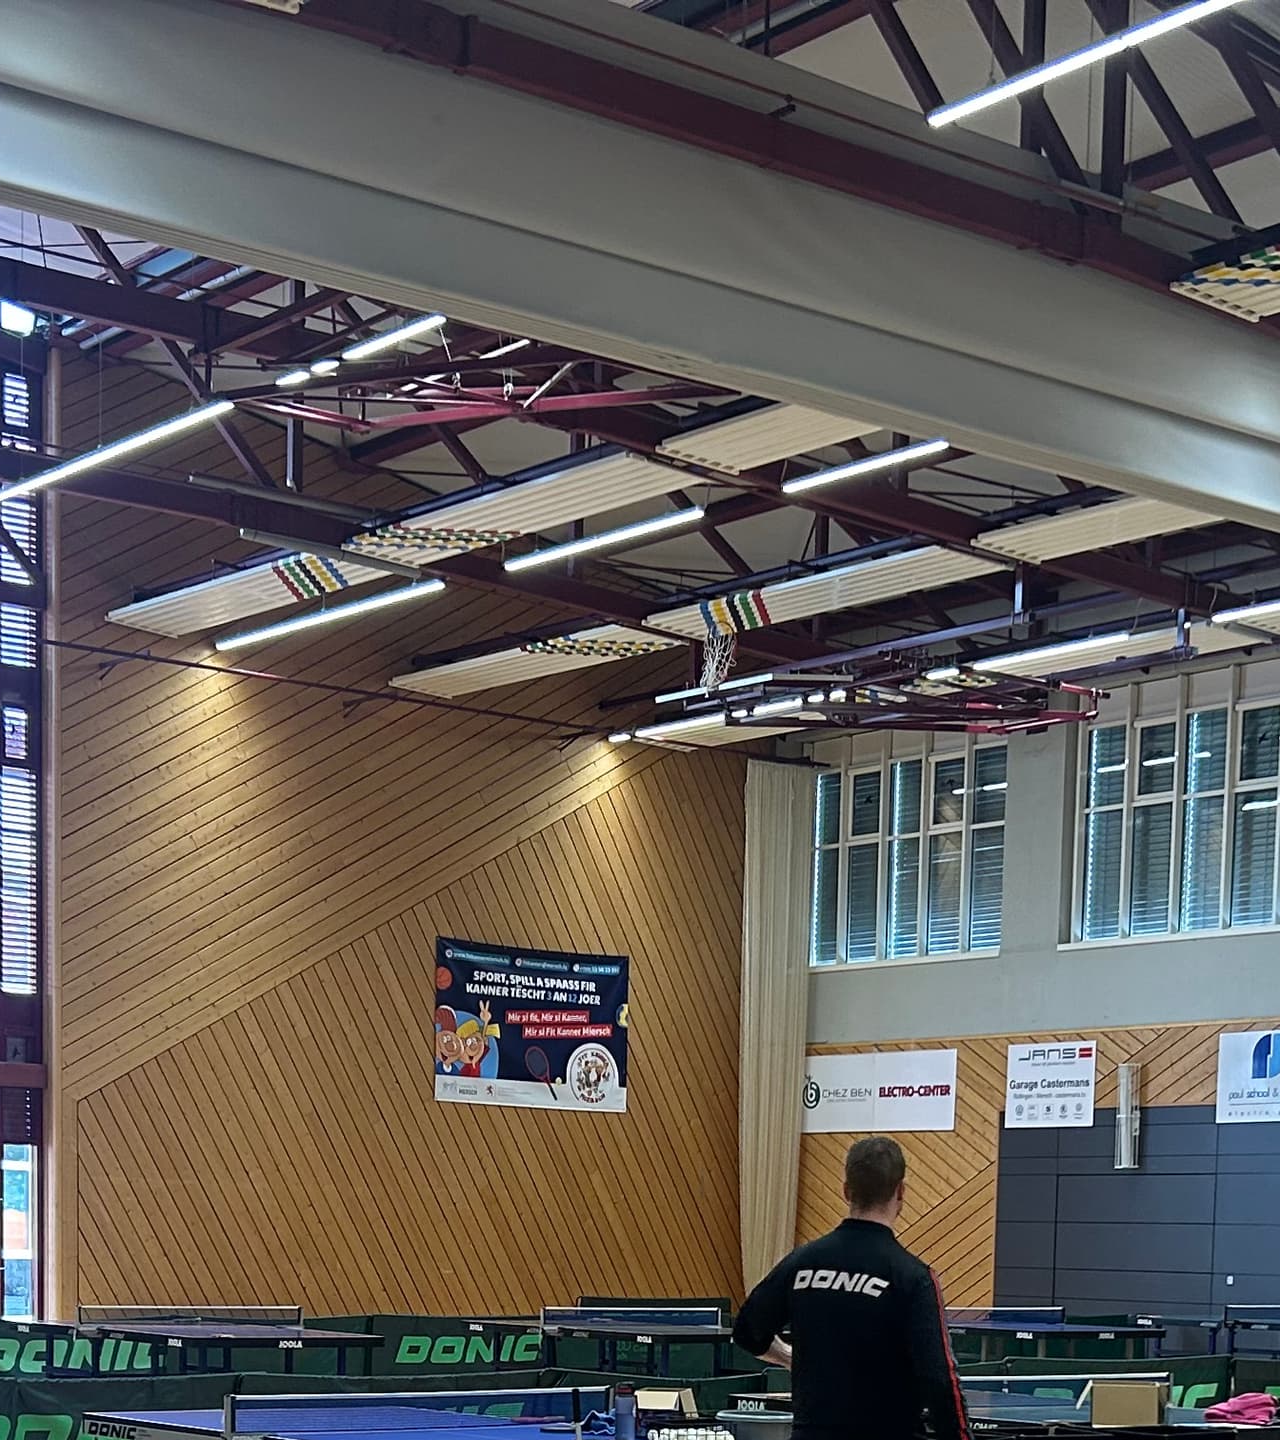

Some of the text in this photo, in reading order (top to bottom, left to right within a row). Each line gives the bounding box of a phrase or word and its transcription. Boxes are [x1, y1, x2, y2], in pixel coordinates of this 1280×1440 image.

[473, 971, 596, 992] SPORT, SPILL A SPAASS FIR
[466, 983, 508, 998] KANNER
[510, 985, 546, 1000] TËSCHT
[553, 992, 567, 1002] AN
[578, 994, 600, 1005] JOER
[850, 1088, 872, 1098] BEN
[879, 1084, 950, 1098] ELECTRO-CENTER
[1009, 1079, 1090, 1091] Garage Castermans
[793, 1270, 890, 1298] DONIC
[395, 1334, 542, 1364] DONIC
[737, 1400, 765, 1411] JOOLA
[88, 1421, 136, 1440] DONIC
